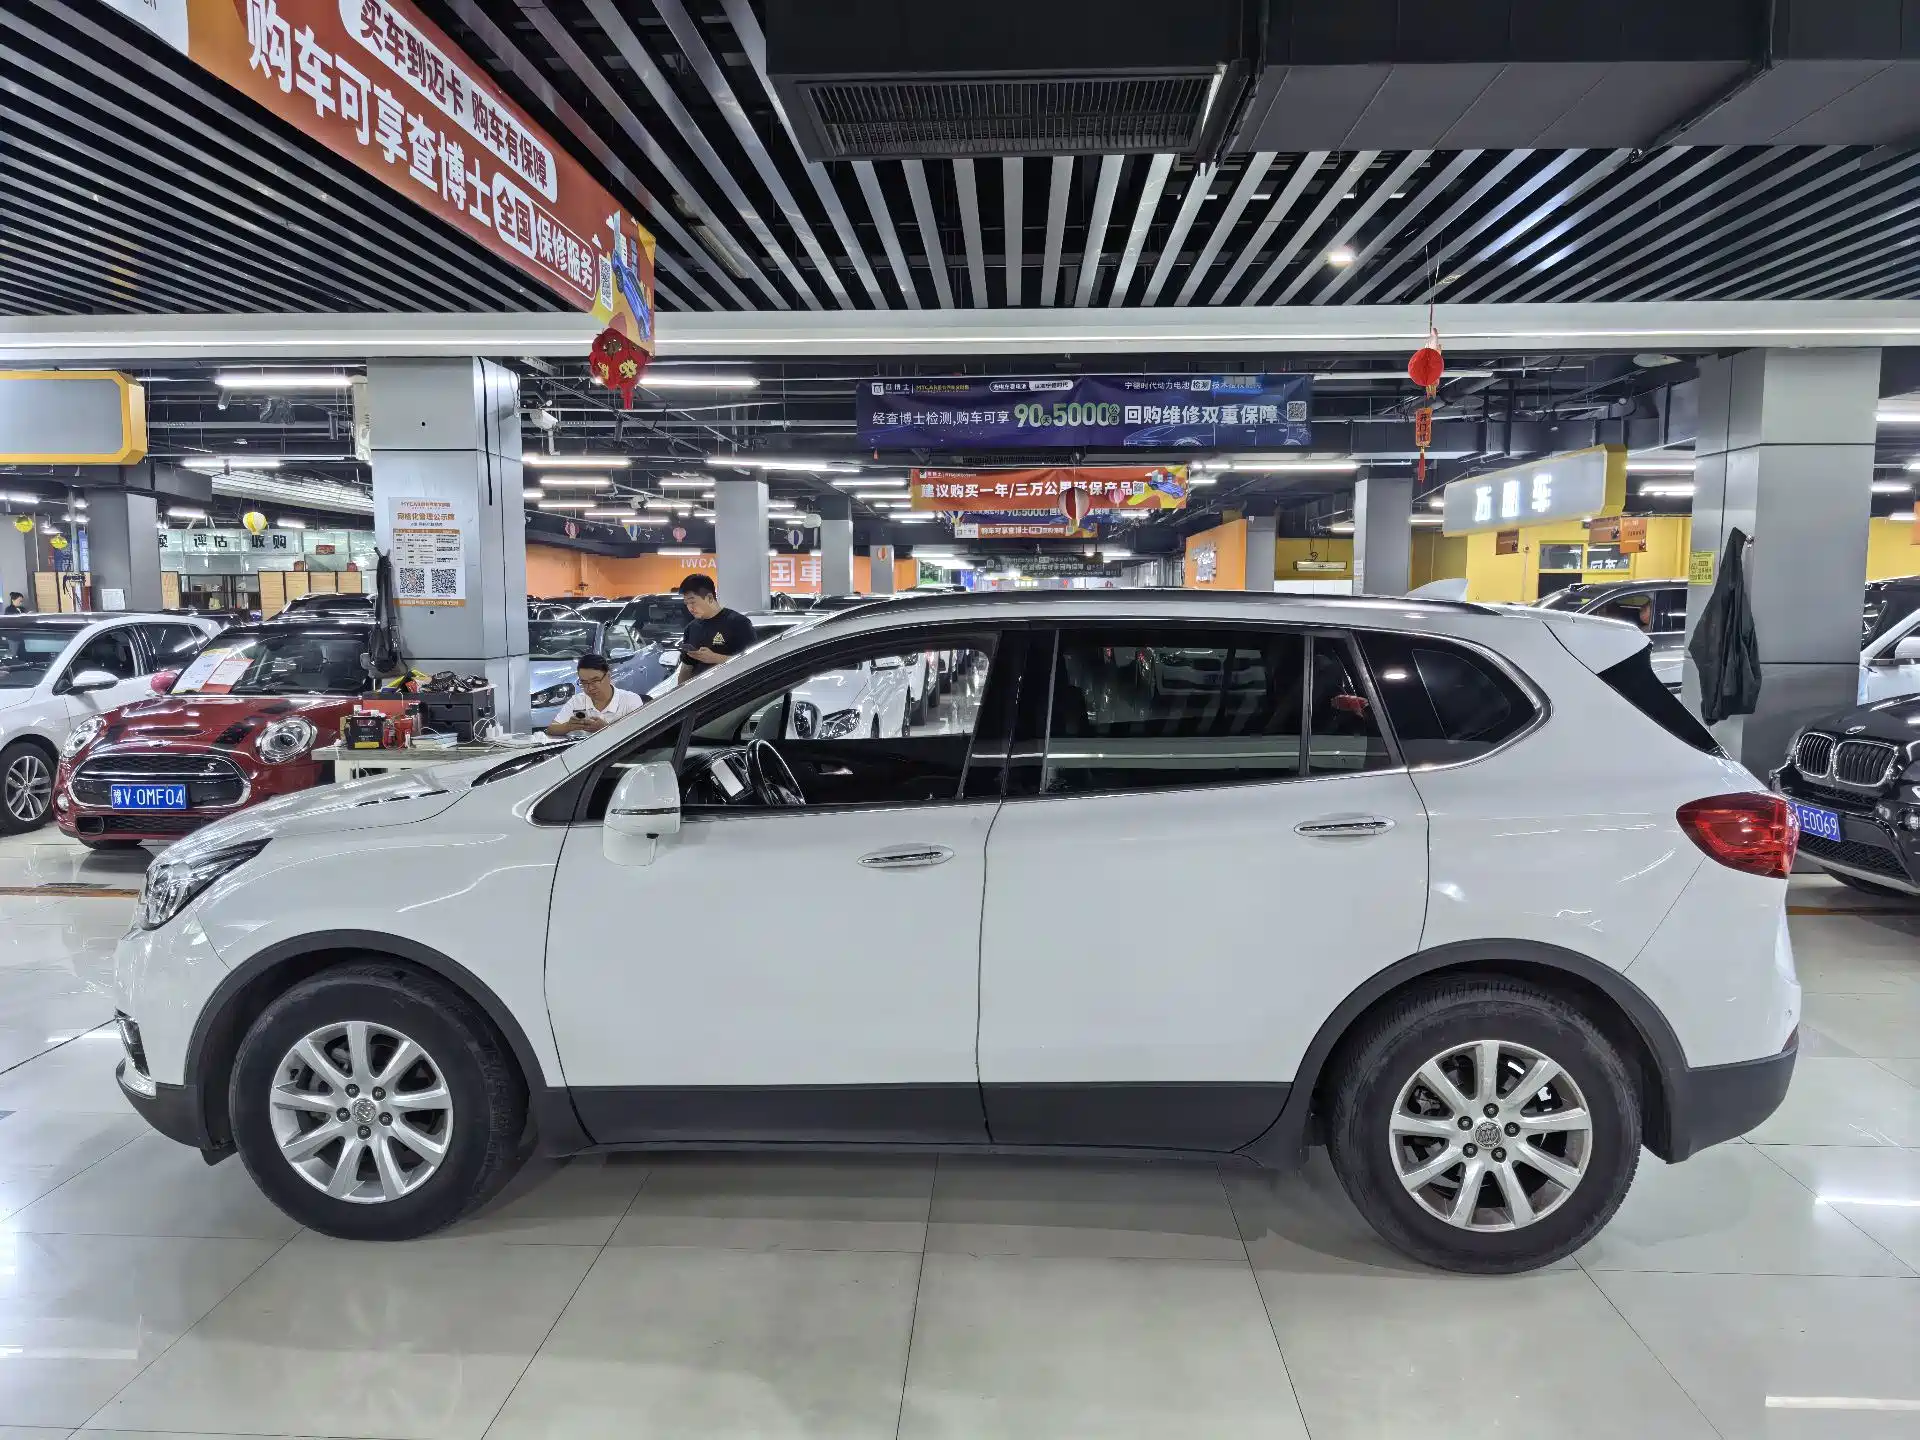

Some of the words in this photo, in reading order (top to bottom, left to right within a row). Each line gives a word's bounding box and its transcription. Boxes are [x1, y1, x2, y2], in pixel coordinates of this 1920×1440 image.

[360, 0, 464, 115] 买车到迈卡
[470, 89, 549, 190] 购车有保障
[193, 534, 228, 548] 评估
[251, 534, 287, 549] 收购
